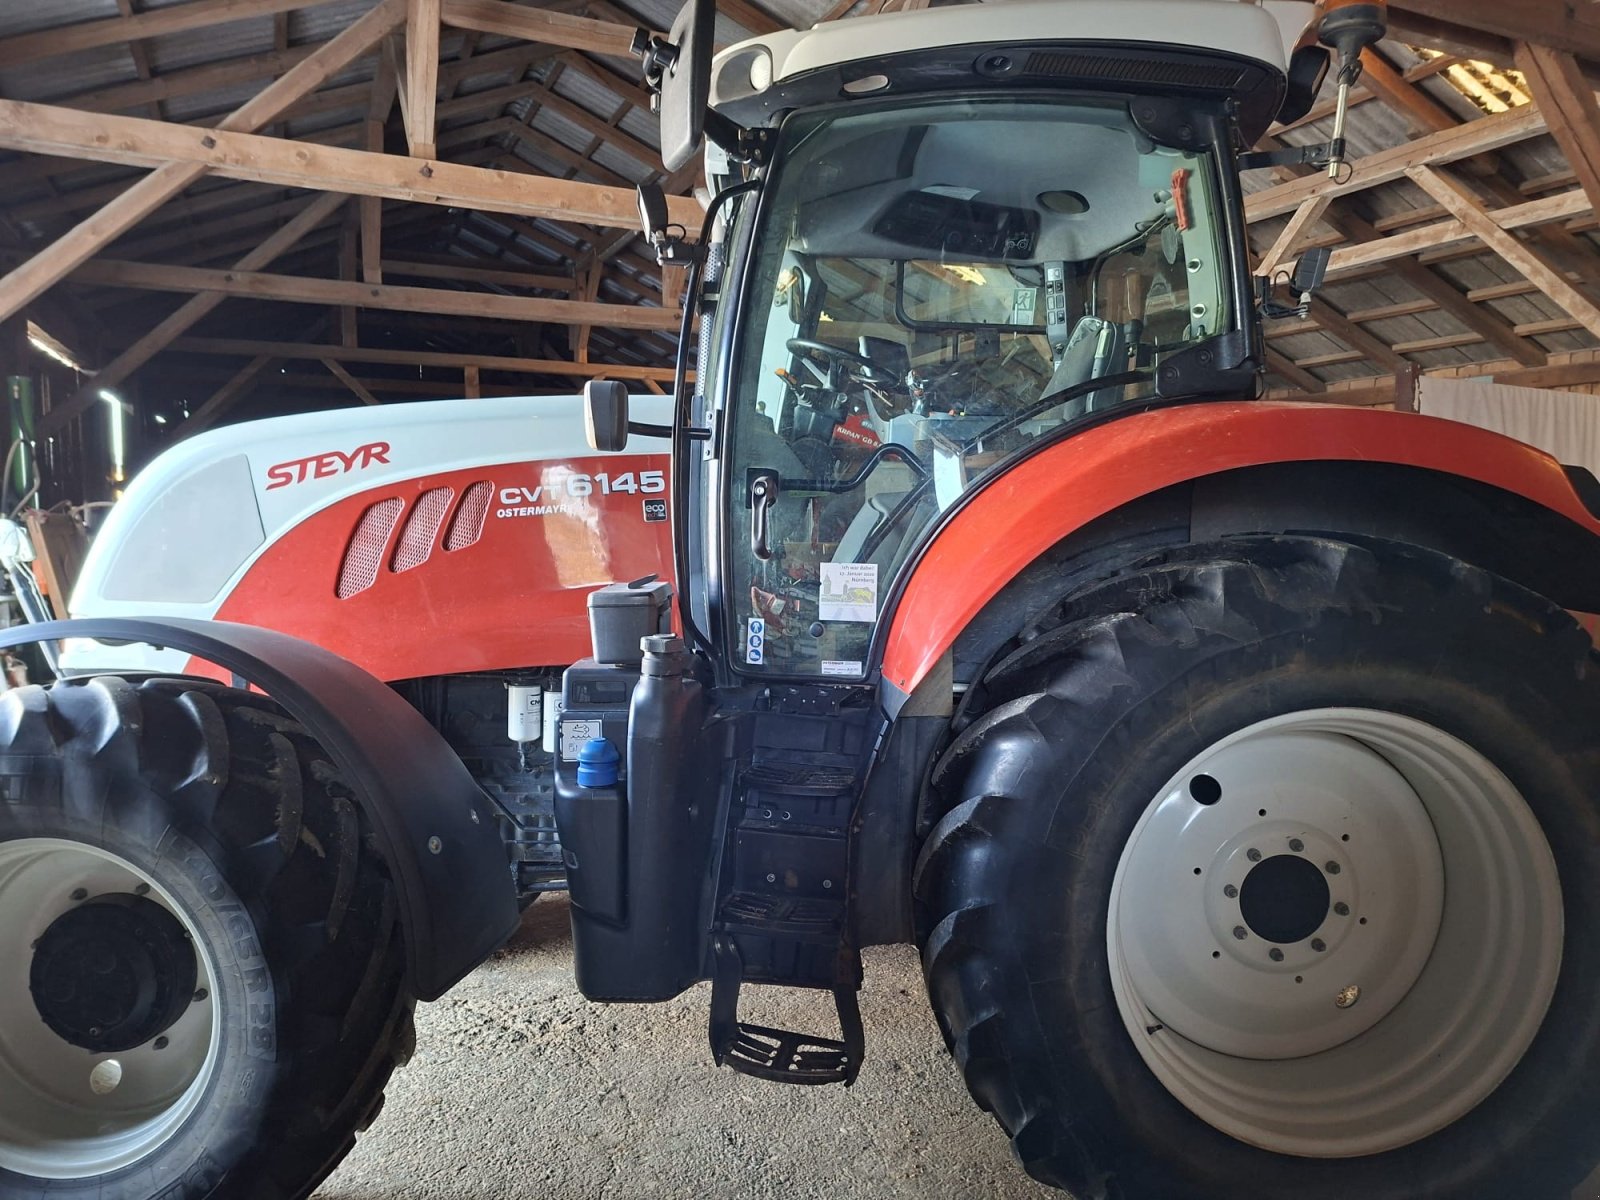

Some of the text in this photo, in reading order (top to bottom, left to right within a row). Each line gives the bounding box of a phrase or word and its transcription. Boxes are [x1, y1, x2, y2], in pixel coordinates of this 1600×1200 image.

[838, 426, 860, 439] KRPAN
[266, 441, 390, 490] STEYR
[499, 470, 666, 505] CVT 6145
[646, 504, 664, 512] eco
